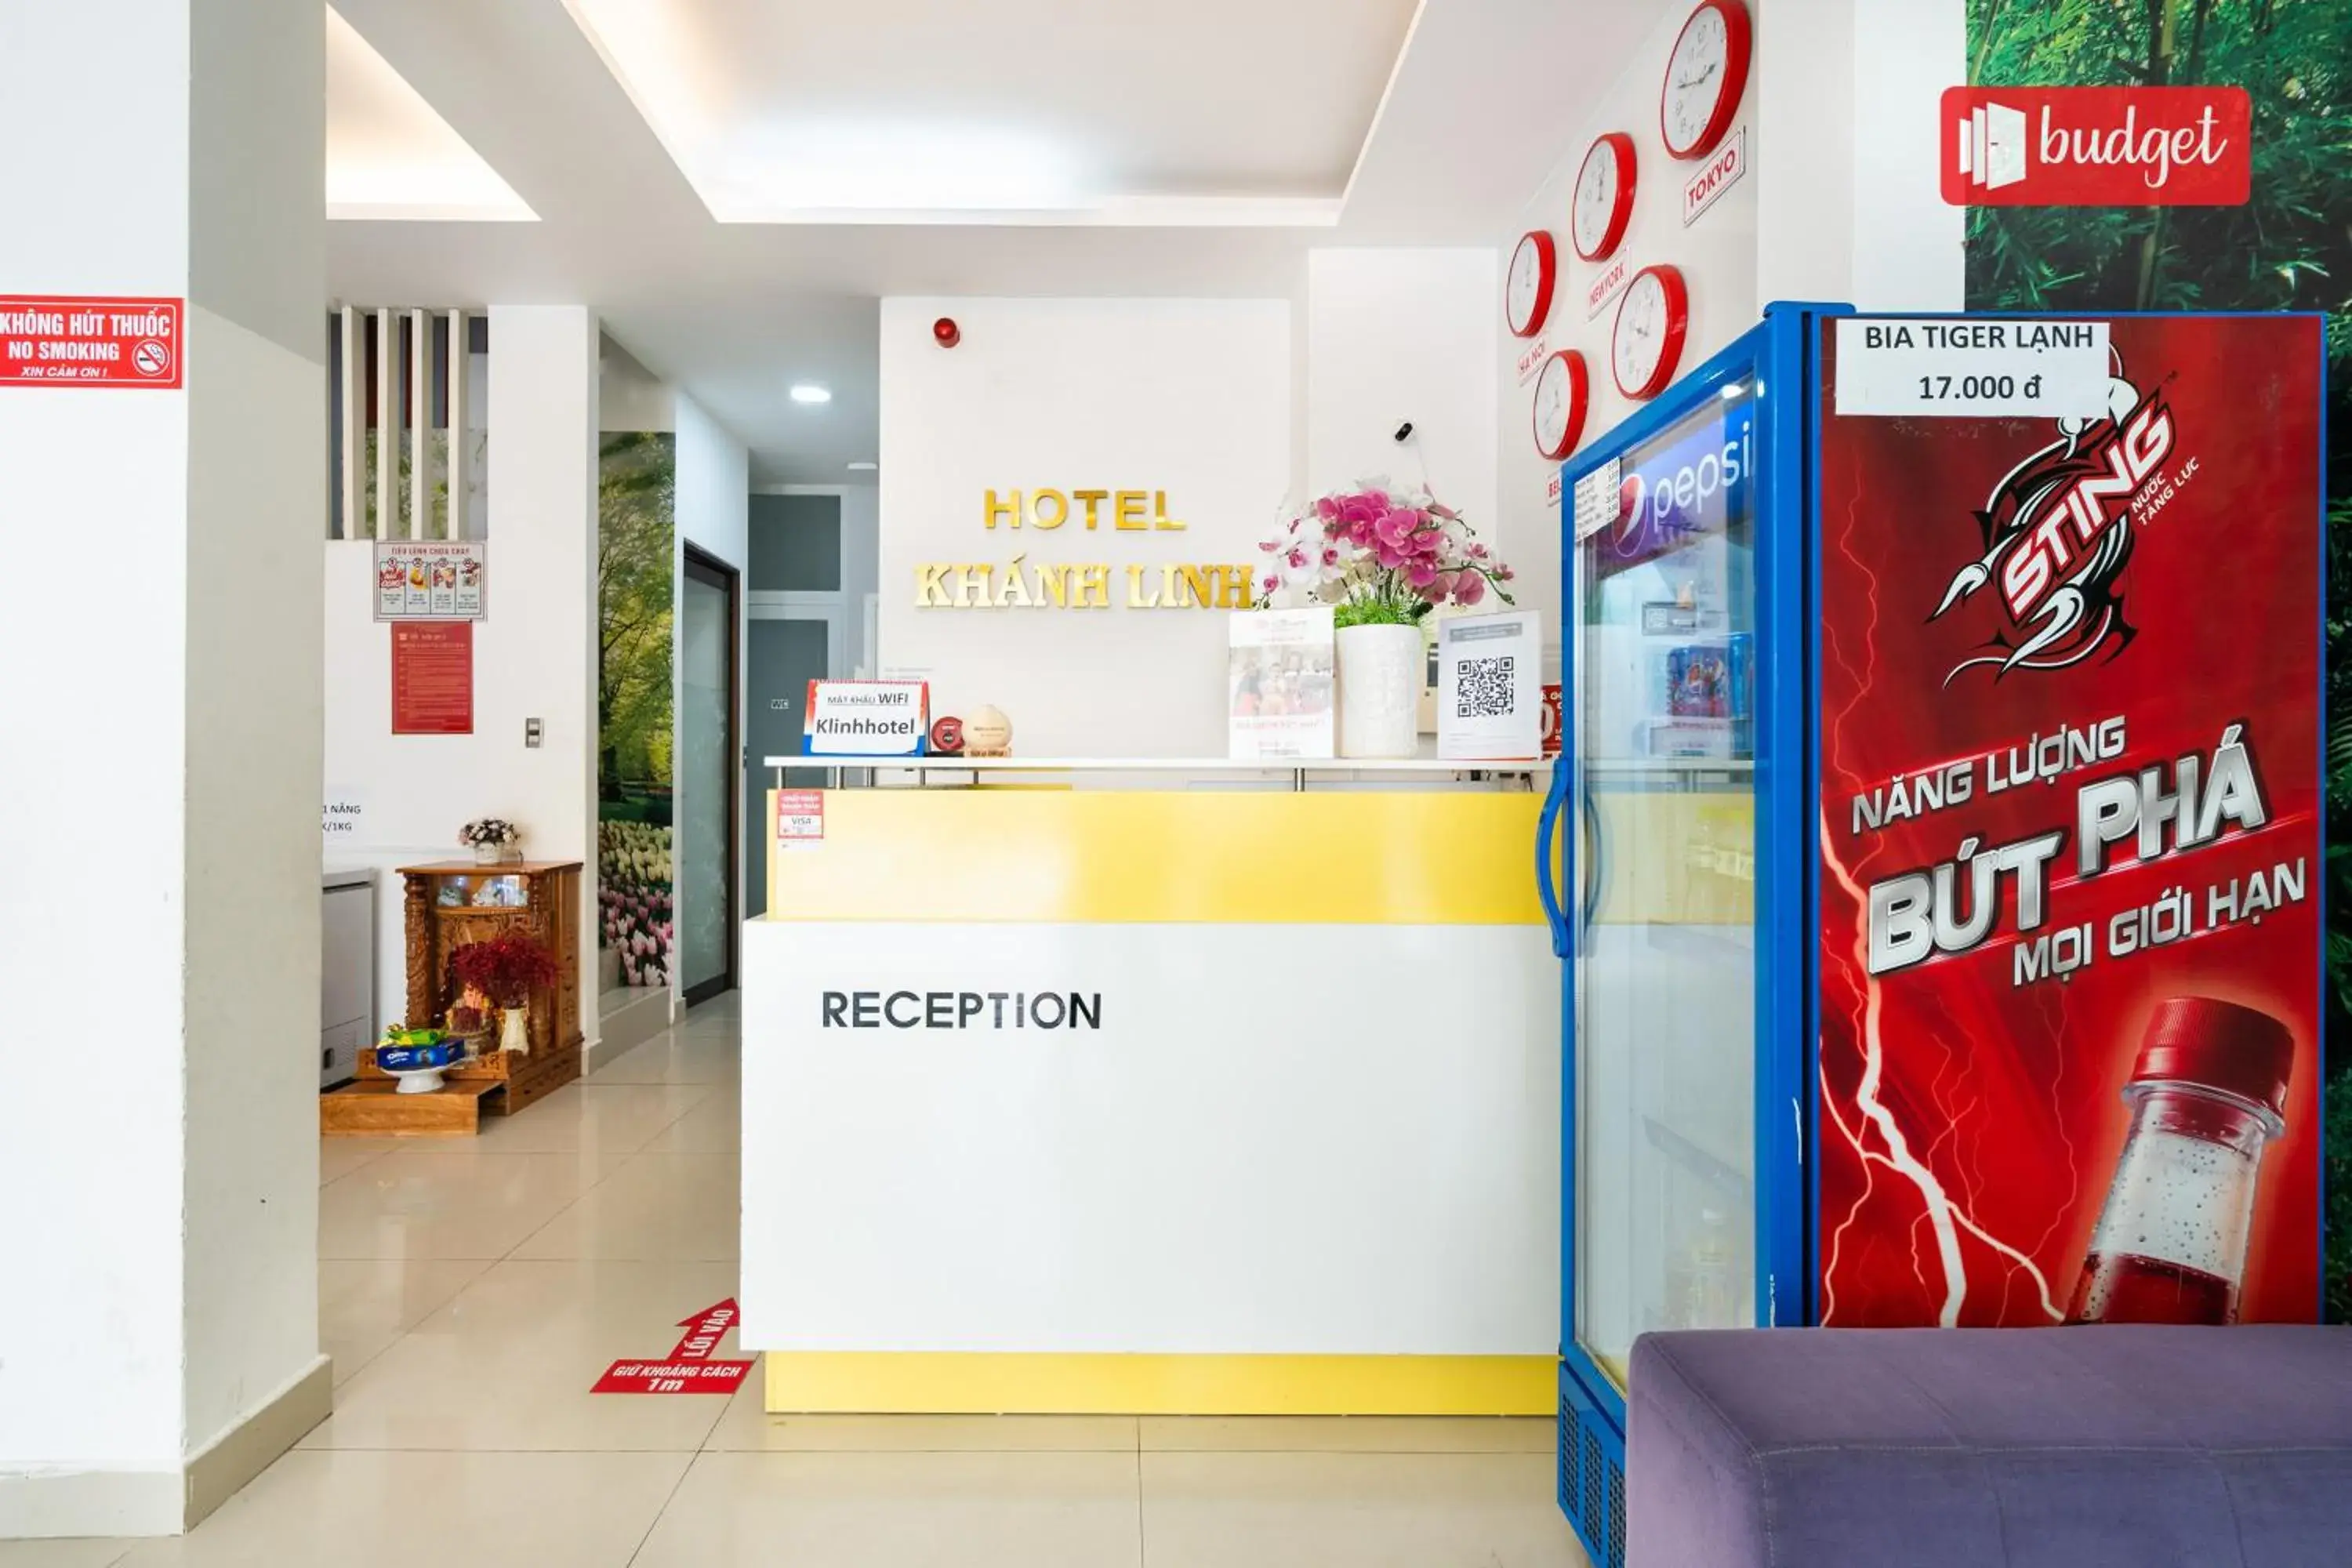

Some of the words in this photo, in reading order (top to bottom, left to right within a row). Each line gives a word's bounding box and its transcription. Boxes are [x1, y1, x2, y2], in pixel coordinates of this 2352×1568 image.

[1689, 150, 1735, 207] TOKYO
[70, 308, 106, 336] HÚT
[109, 307, 171, 337] THUỐC
[1865, 325, 1915, 349] BIA
[1922, 325, 2006, 349] TIGER
[2016, 325, 2093, 354] LẠNH
[9, 341, 33, 360] NO
[38, 341, 120, 361] SMOKING
[21, 366, 43, 377] XIN
[1919, 376, 2015, 399] 17.000
[2023, 374, 2043, 399] đ
[1653, 420, 1750, 534] pepsi
[2132, 471, 2166, 514] NƯỚC
[2138, 485, 2174, 525] TĂNG
[2174, 456, 2199, 487] LỰC
[983, 488, 1188, 532] HOTEL
[2004, 403, 2172, 615] STING
[913, 553, 1112, 609] KHÁNH
[1125, 563, 1255, 609] LINH
[878, 692, 909, 703] WIFI
[815, 717, 915, 735] Klinhhotel
[1852, 760, 1973, 834] NĂNG
[1987, 714, 2125, 793] LƯỢNG
[1868, 831, 2063, 974] BỨT
[2078, 724, 2267, 877] PHÁ
[2013, 921, 2092, 985] MỌI
[2109, 885, 2192, 956] GIỚI
[2208, 857, 2306, 927] HẠN
[822, 990, 1102, 1029] RECEPTION
[700, 1365, 742, 1378] CÁCH
